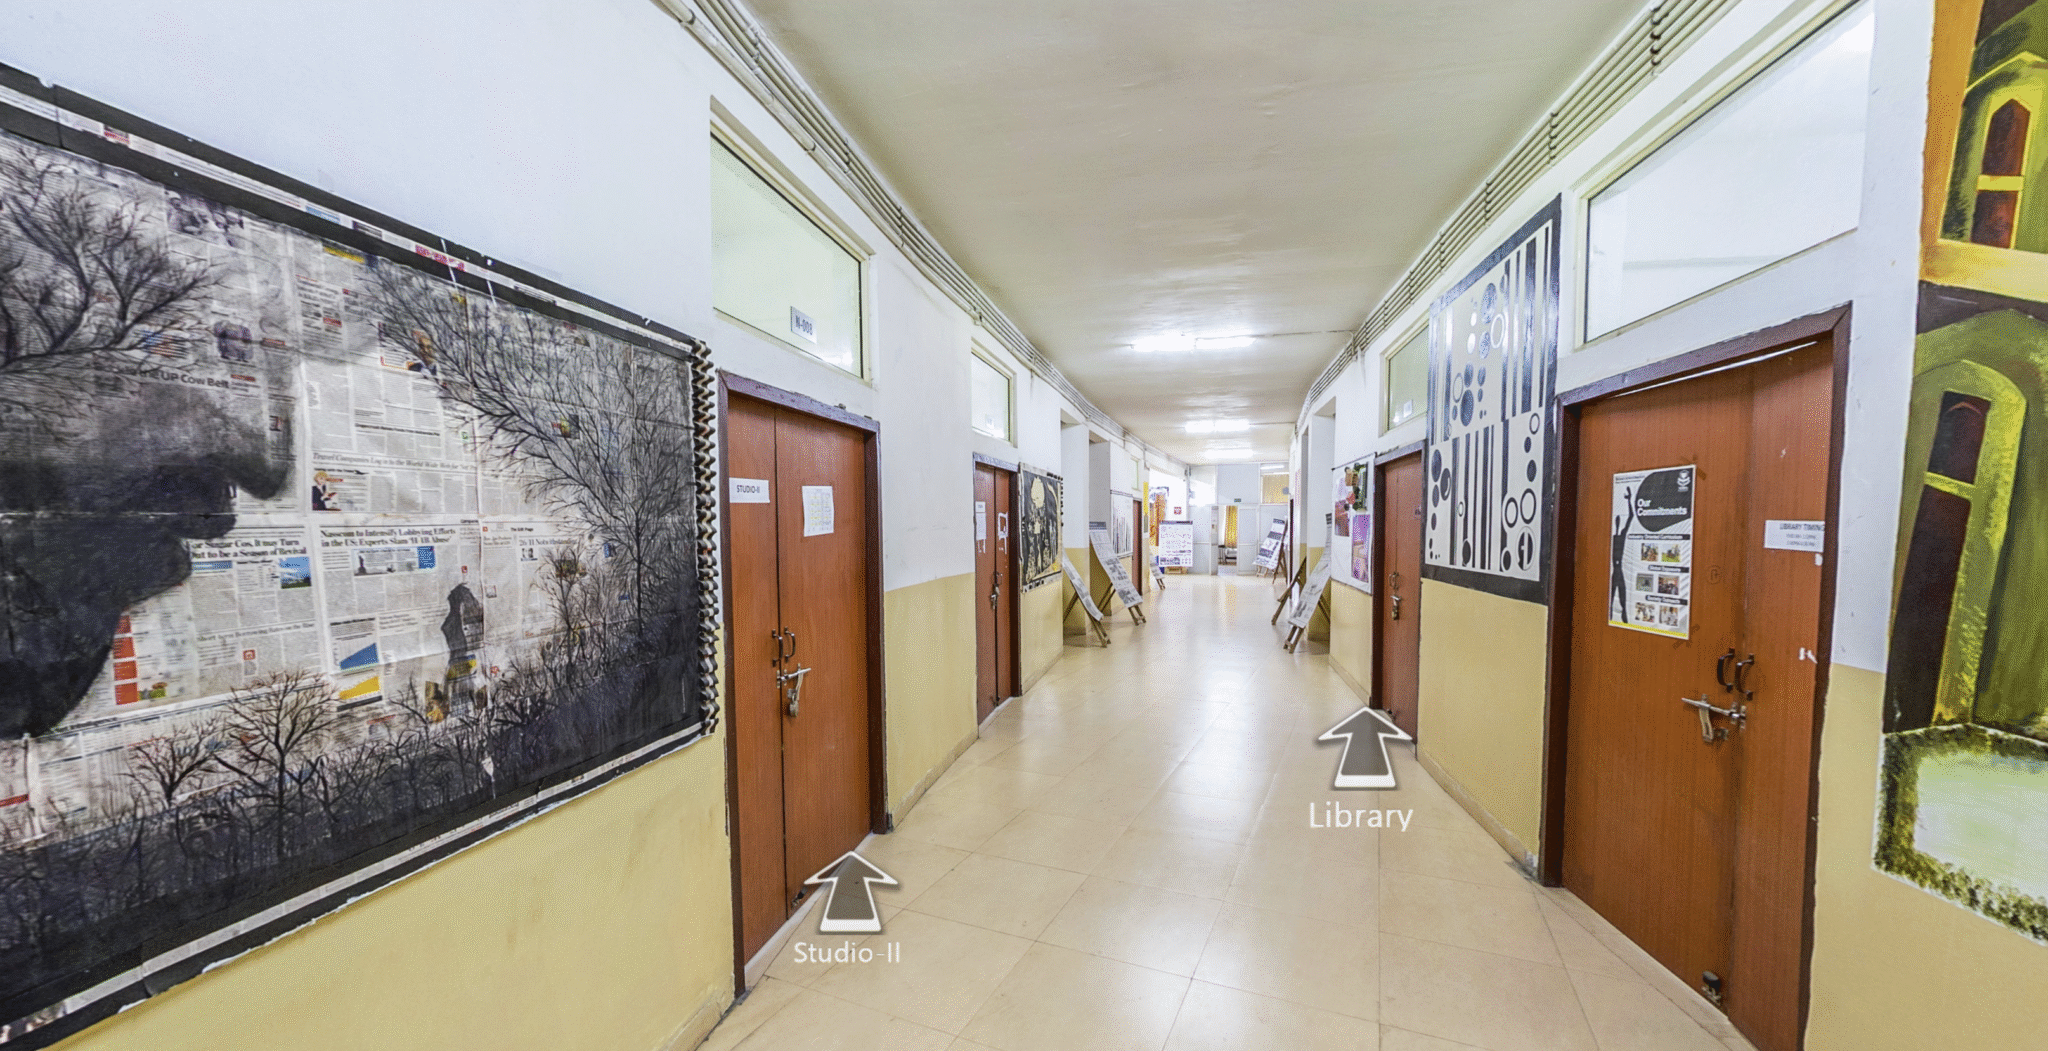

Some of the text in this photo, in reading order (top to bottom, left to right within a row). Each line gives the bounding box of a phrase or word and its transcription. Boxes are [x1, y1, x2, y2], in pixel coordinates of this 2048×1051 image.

[160, 371, 179, 381] UP
[180, 374, 205, 384] Cow
[207, 377, 230, 388] Belt
[1637, 499, 1651, 507] Our
[1637, 507, 1687, 516] Commitments
